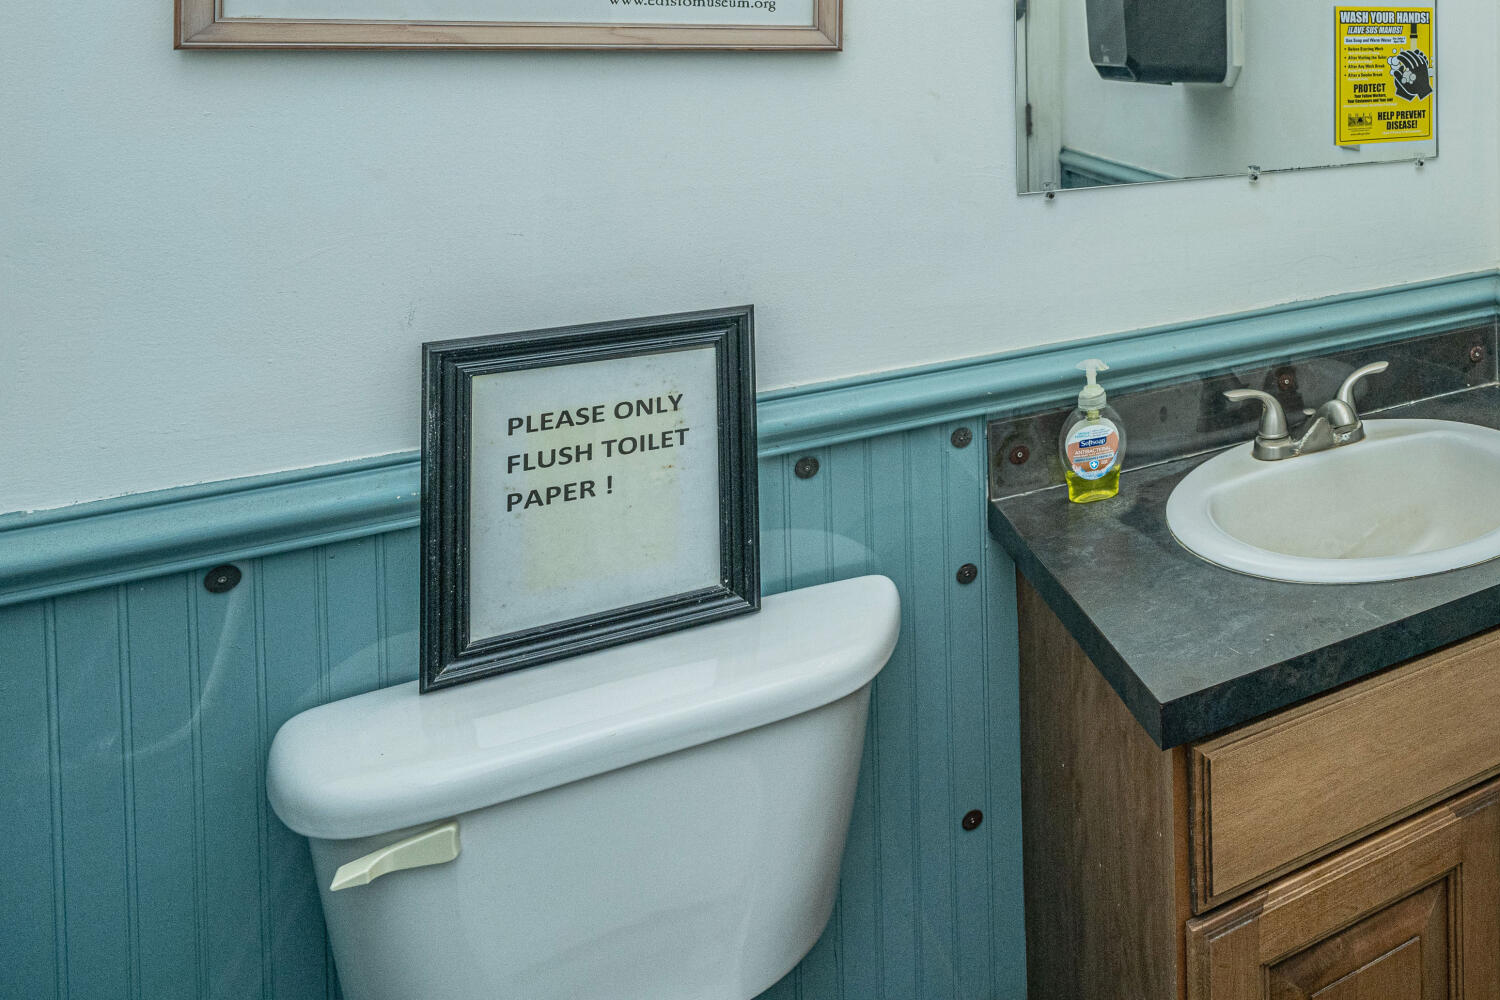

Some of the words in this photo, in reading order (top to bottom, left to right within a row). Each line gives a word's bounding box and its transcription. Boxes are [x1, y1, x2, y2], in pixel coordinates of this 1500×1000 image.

[1339, 11, 1369, 24] WASH
[1370, 11, 1395, 24] YOUR
[1396, 11, 1430, 24] HANDS!
[1353, 83, 1386, 93] PROTECT
[1377, 111, 1395, 121] HELP
[1396, 109, 1426, 120] PREVENT
[1386, 120, 1418, 130] DISEASE!
[507, 404, 605, 436] PLEASE
[613, 393, 683, 420] ONLY
[1080, 438, 1106, 447] Softsoap
[507, 443, 593, 474] FLUSH
[601, 427, 690, 458] TOILET
[506, 480, 596, 512] PAPER
[606, 475, 613, 494] !
